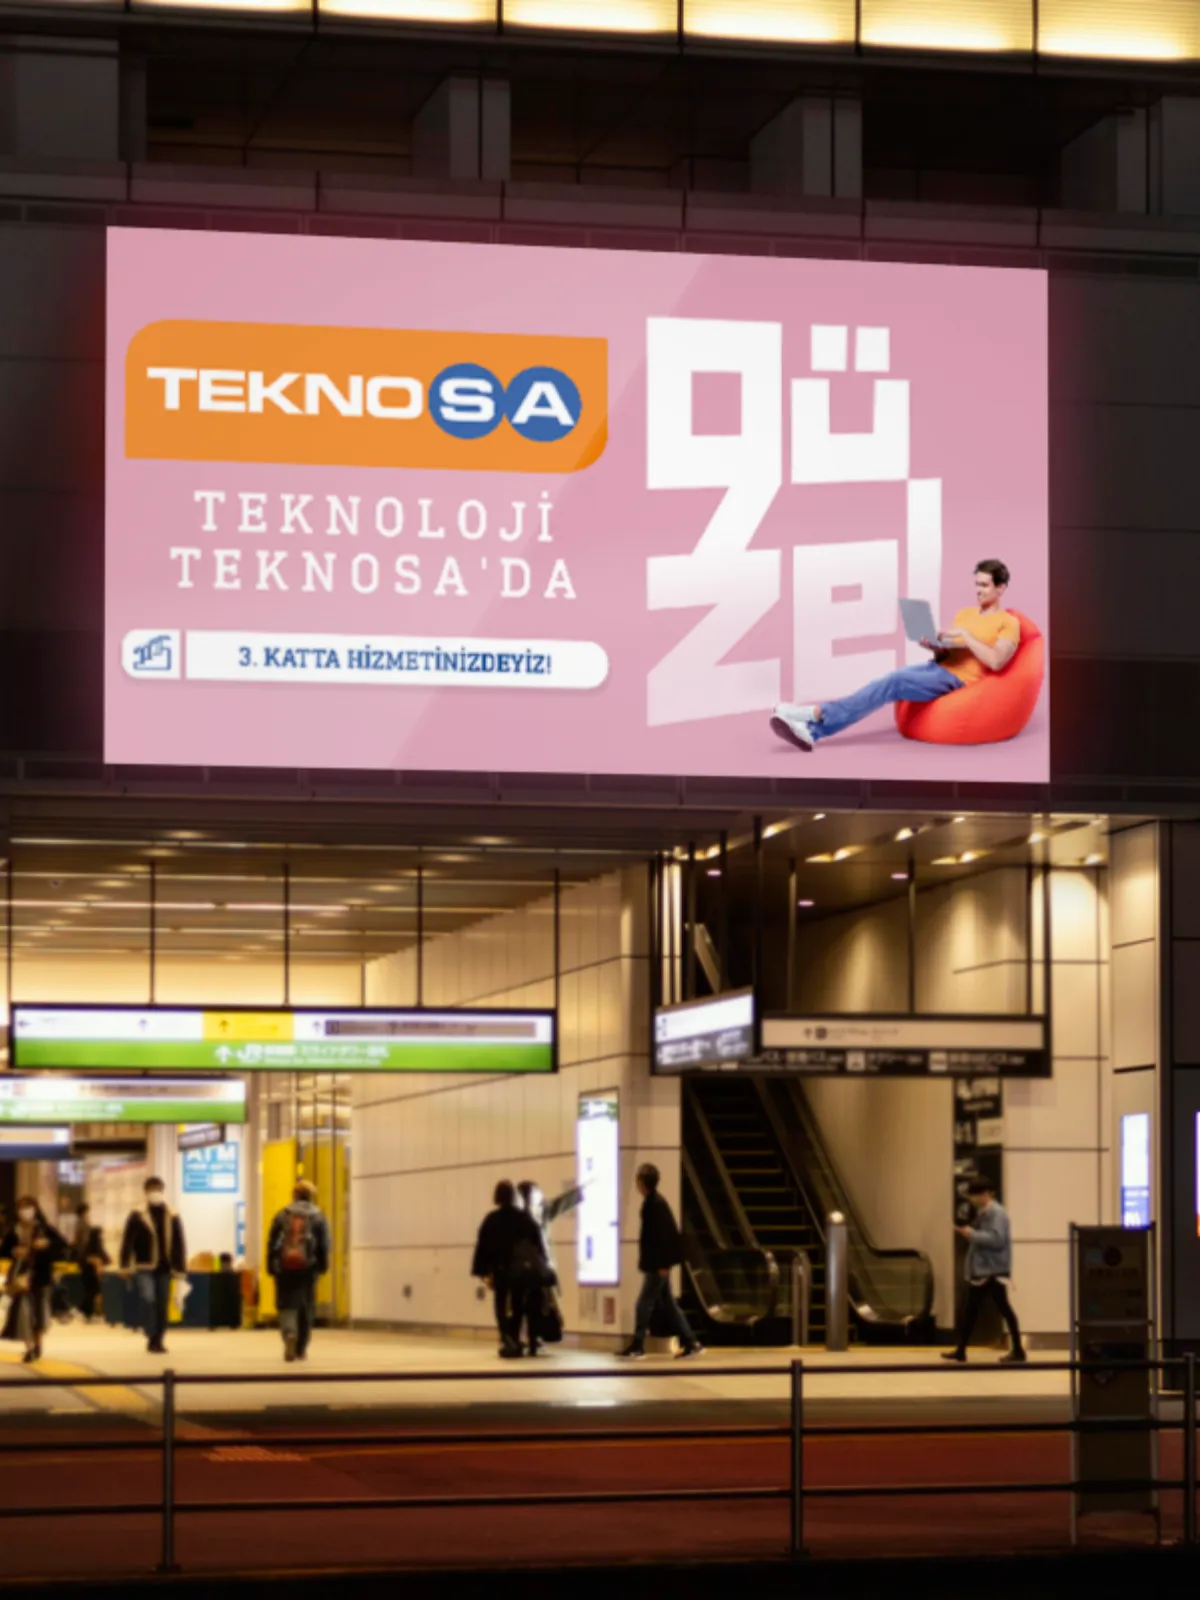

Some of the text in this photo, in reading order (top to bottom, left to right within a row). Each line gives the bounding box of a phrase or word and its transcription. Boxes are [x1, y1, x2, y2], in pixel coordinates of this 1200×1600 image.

[146, 366, 576, 427] TEKNOSA
[193, 490, 555, 543] TEKNOLOJİ
[169, 546, 578, 600] TEKNOSA'DA
[238, 643, 552, 675] 3. KATTA HİZMETİNİZDEYİZ!
